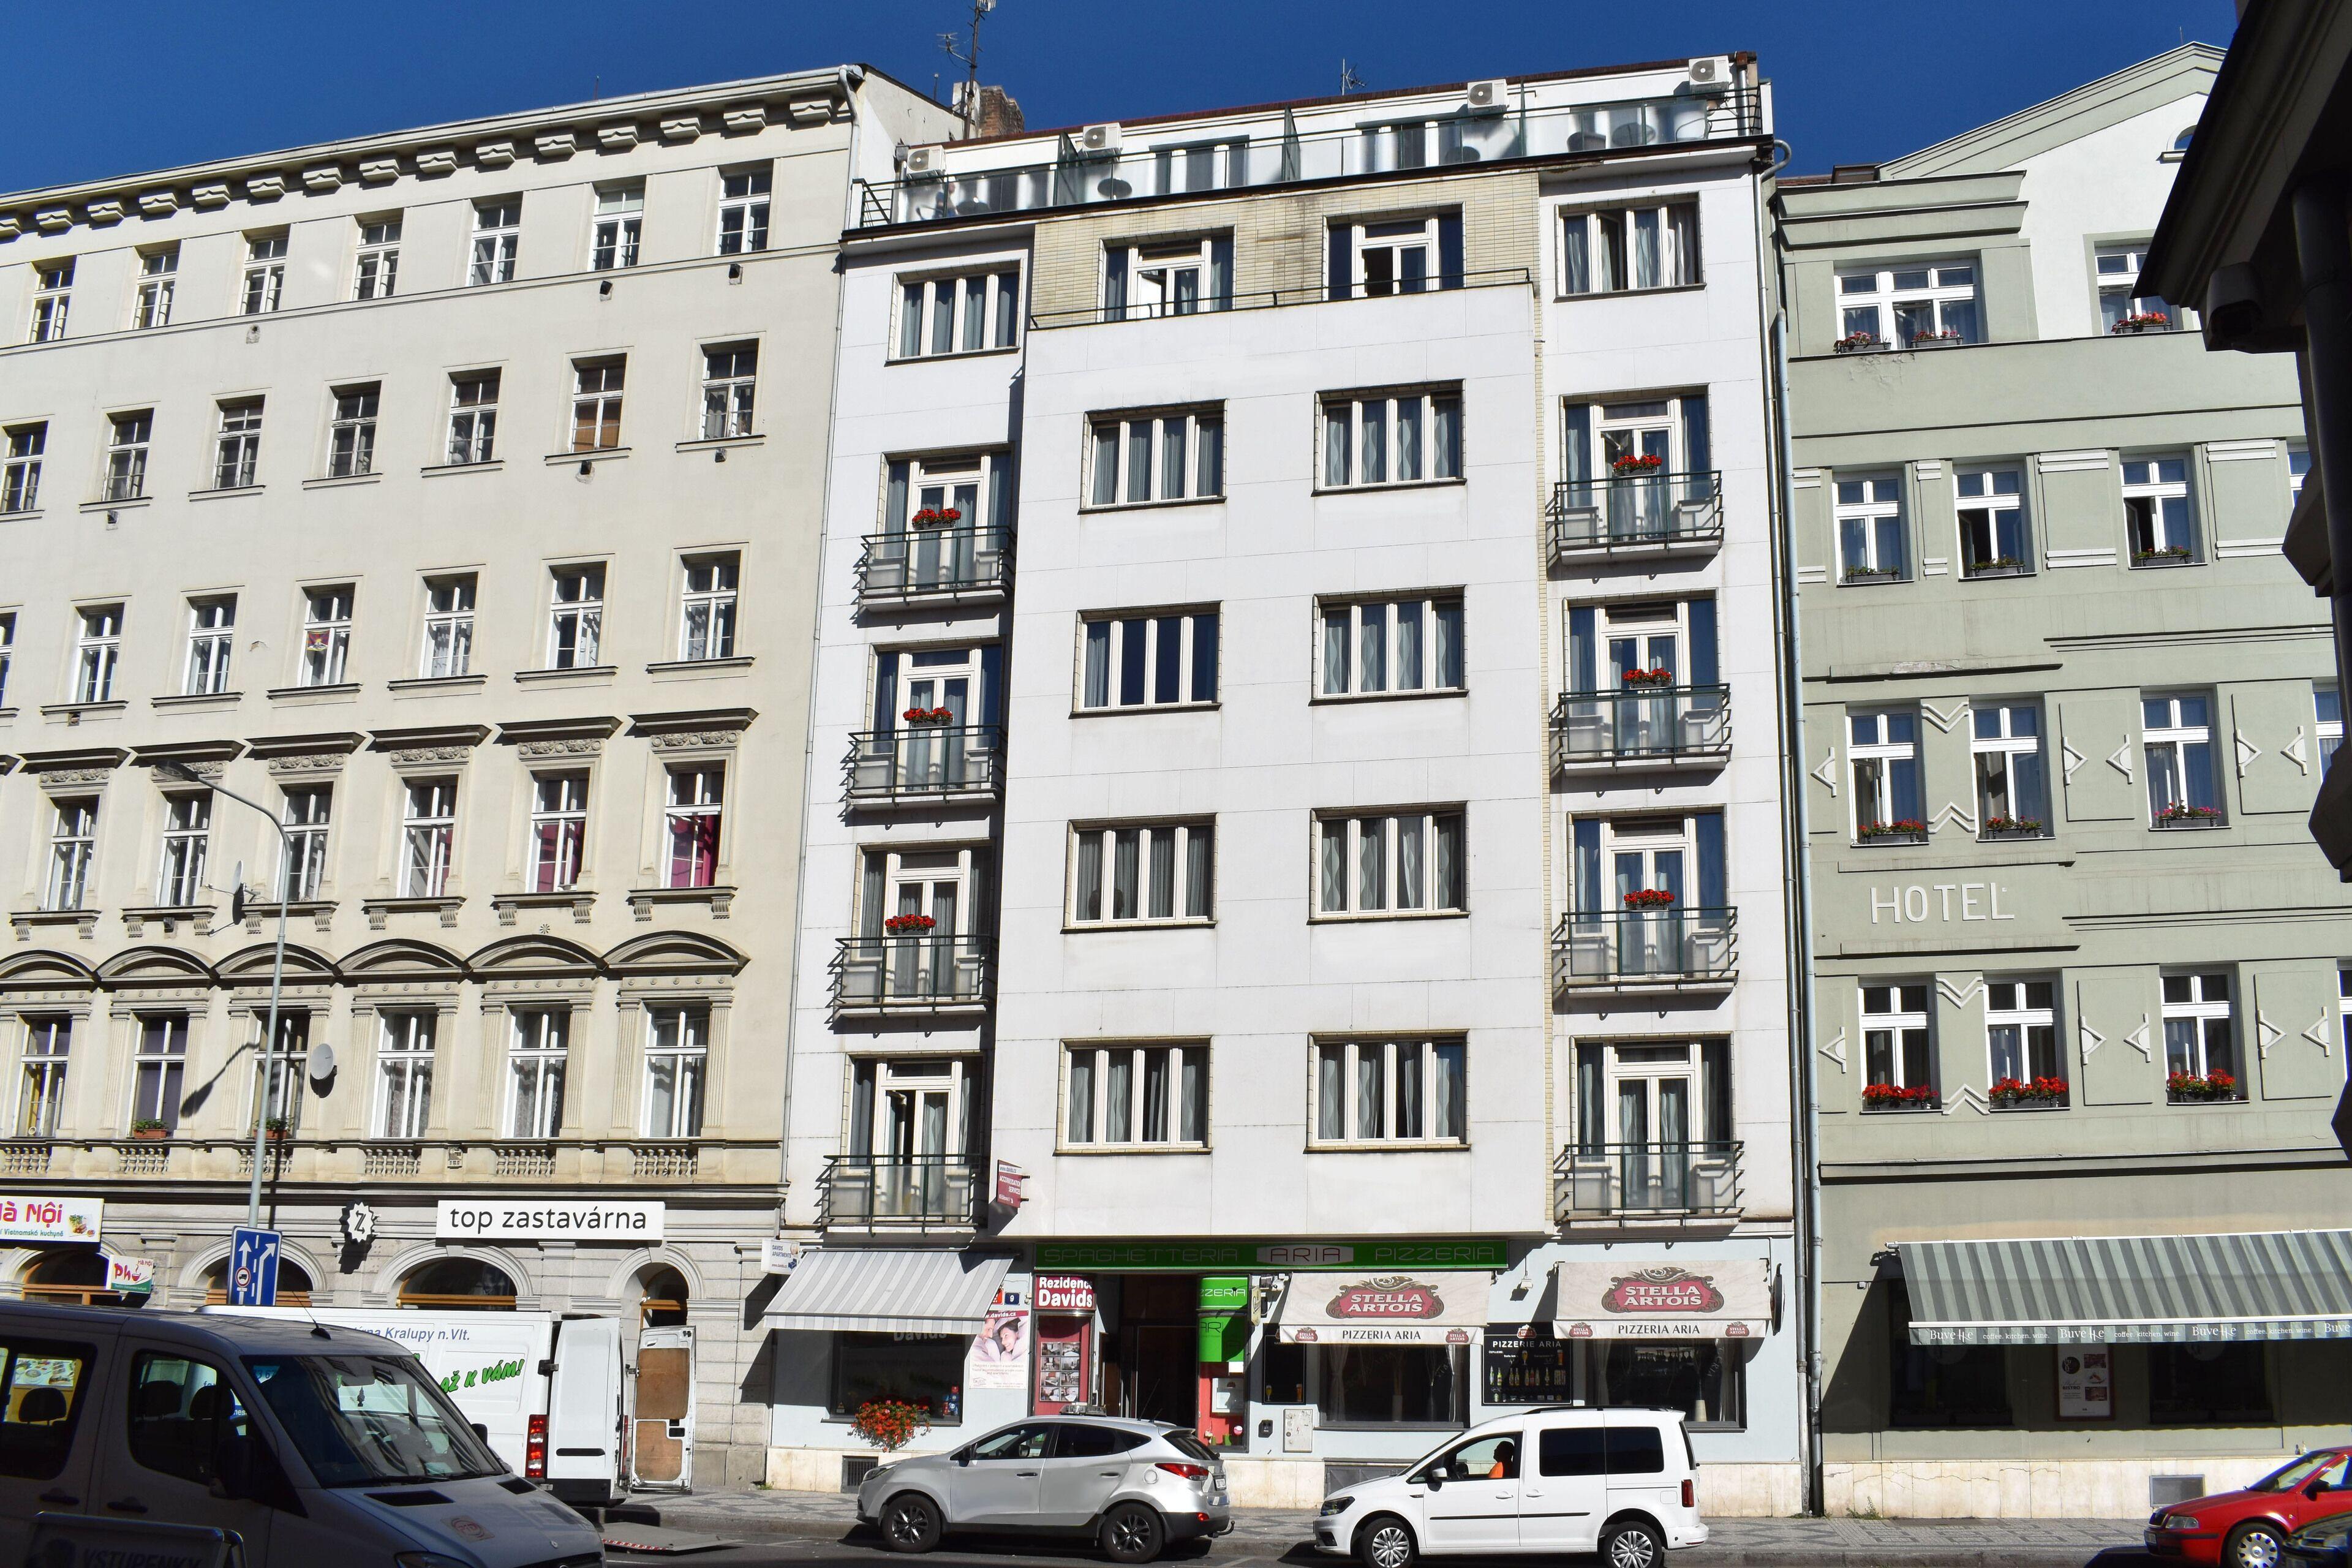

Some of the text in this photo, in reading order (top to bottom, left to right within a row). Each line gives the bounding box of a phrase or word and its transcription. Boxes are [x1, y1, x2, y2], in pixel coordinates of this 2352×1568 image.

[1871, 882, 2015, 924] HOTEL
[0, 1200, 62, 1228] à Nội
[450, 1206, 646, 1235] top zastavárna
[1044, 1246, 1494, 1263] SPAGHETTERIA ARIA PIZZERIA
[1625, 1286, 1701, 1295] STELLA
[1038, 1289, 1093, 1308] Davids
[1351, 1294, 1423, 1303] STELLA
[1624, 1296, 1702, 1306] ARTOIS
[1348, 1303, 1423, 1313] ARTOIS
[385, 1327, 434, 1342] Kralupy
[1343, 1330, 1422, 1340] PIZZERIA ARIA
[1618, 1325, 1700, 1335] PIZZERIA ARIA
[440, 1359, 526, 1394] AŽ K VÁM!
